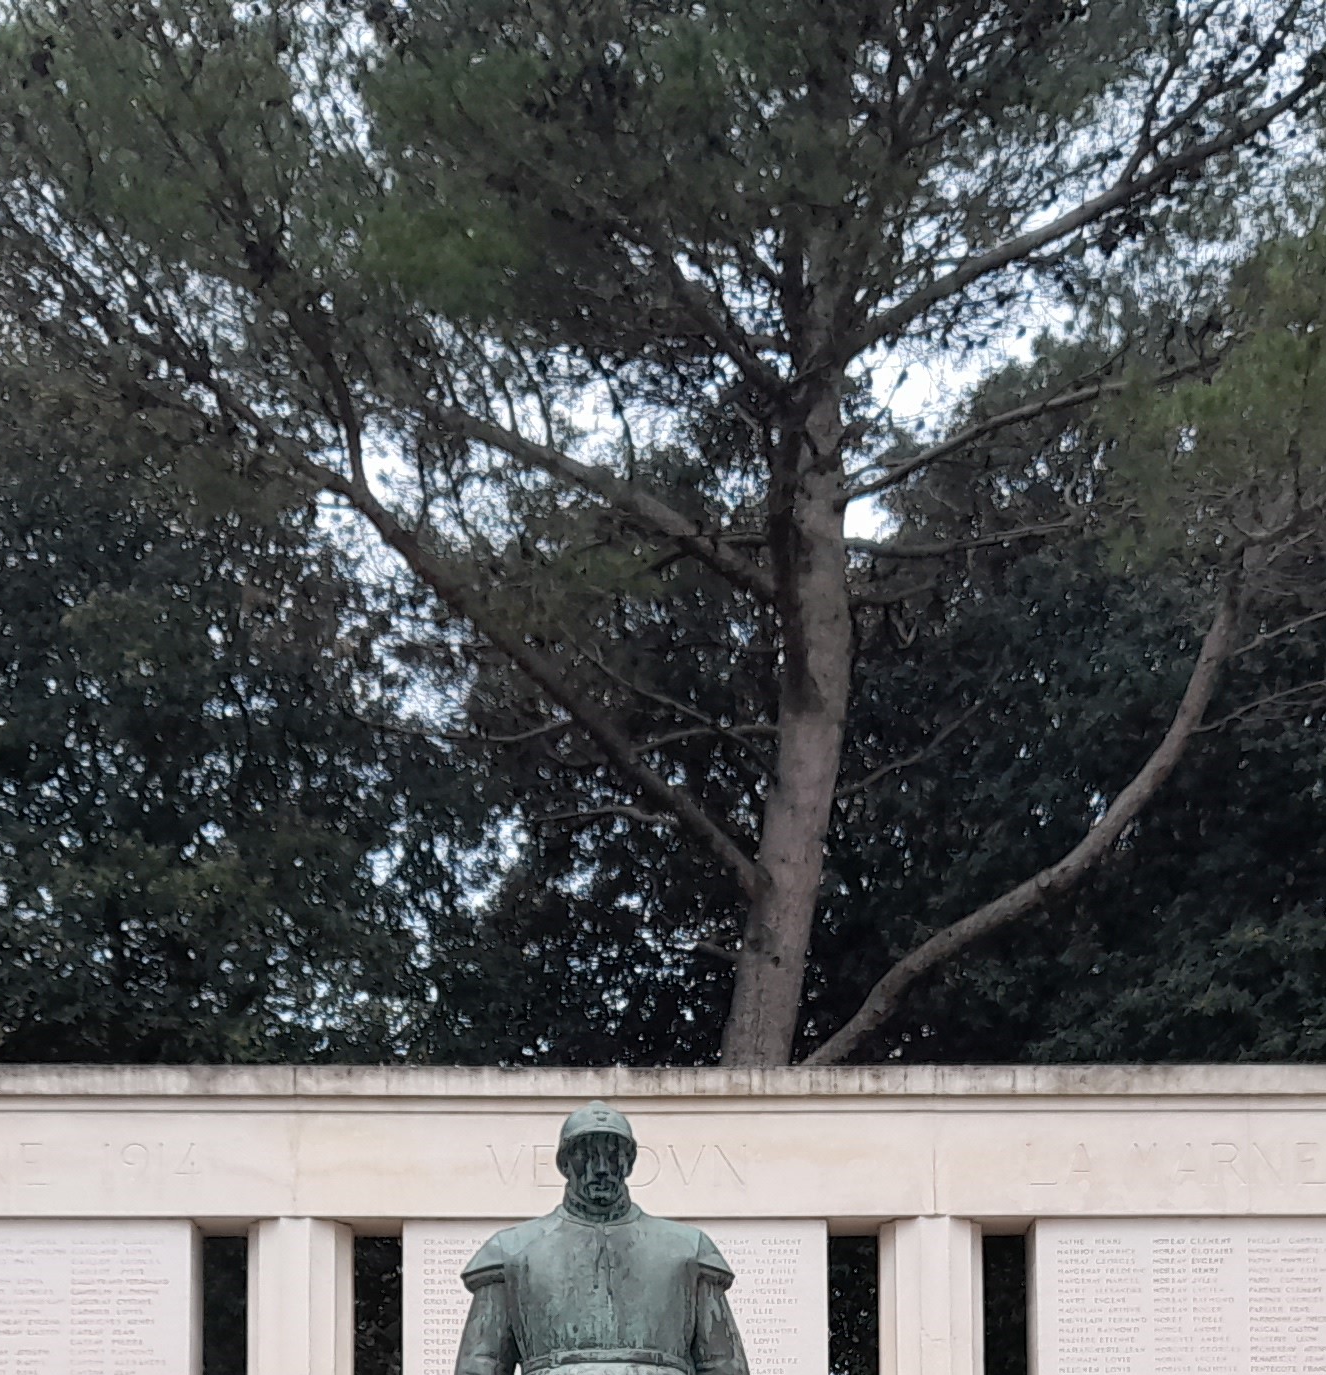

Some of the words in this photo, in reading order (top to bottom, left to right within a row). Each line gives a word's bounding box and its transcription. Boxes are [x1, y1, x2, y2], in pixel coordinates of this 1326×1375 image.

[100, 1140, 203, 1188] 1914
[483, 1142, 748, 1190] VEDVN
[1024, 1140, 1093, 1188] LA
